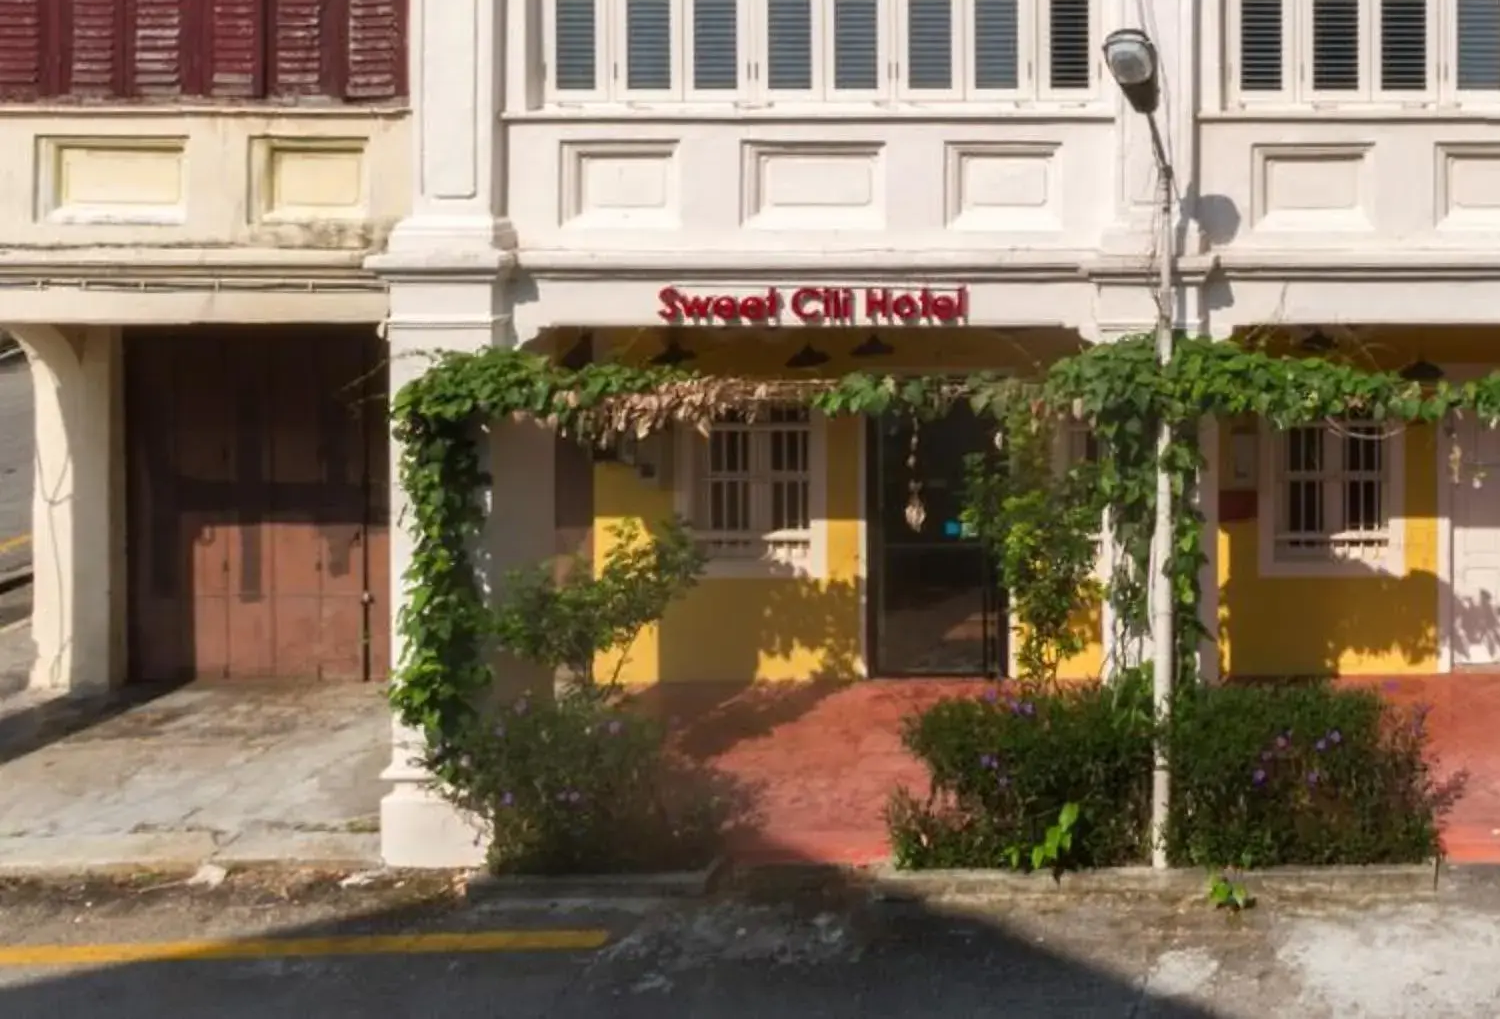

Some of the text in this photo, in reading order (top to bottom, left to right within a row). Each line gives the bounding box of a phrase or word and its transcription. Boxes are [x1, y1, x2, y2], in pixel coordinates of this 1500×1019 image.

[658, 285, 968, 321] Sweet Cili Hotel
